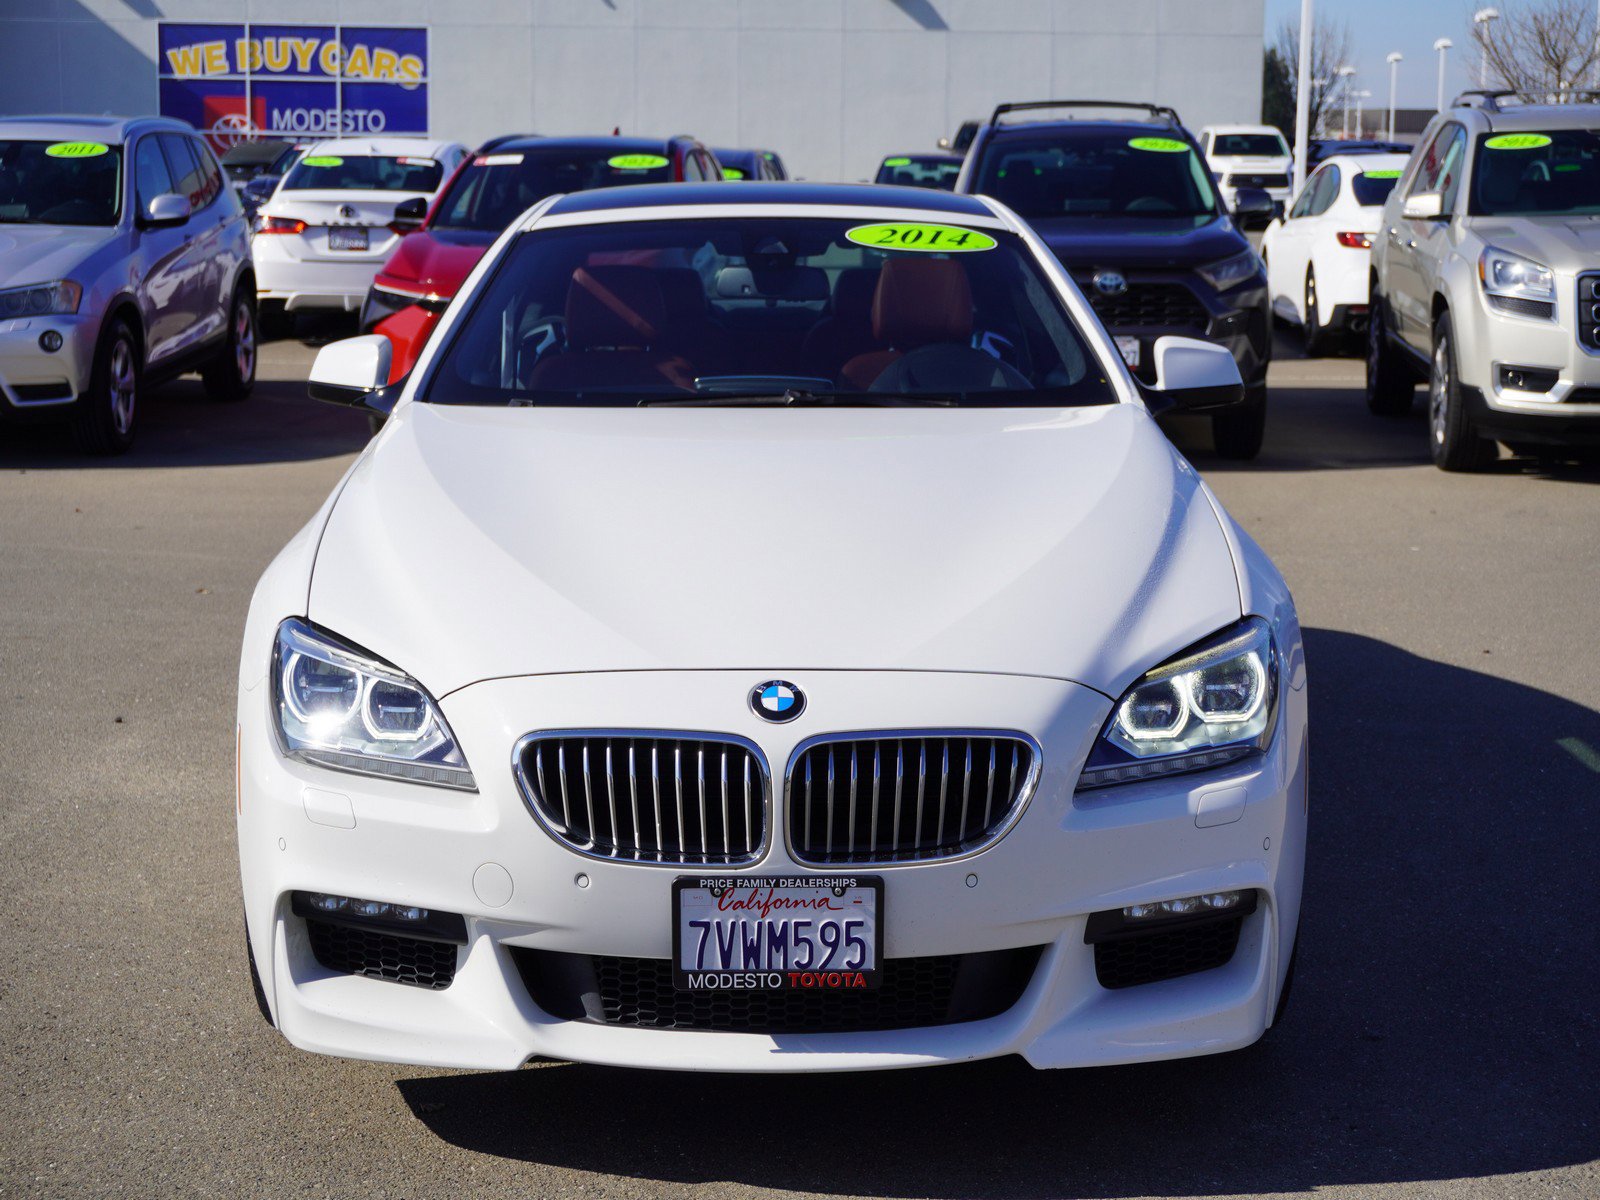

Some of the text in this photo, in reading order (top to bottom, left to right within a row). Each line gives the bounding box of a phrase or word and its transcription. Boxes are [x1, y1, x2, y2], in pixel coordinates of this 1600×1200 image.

[167, 37, 425, 90] WE BUY CARS
[271, 108, 386, 133] MODESTO
[874, 228, 971, 246] 2014
[700, 878, 857, 888] PRICE FAMILY DEALERSHIPS
[718, 888, 843, 918] California
[688, 920, 866, 970] 7VWM595
[688, 972, 867, 989] MODESTO TOYOTA
